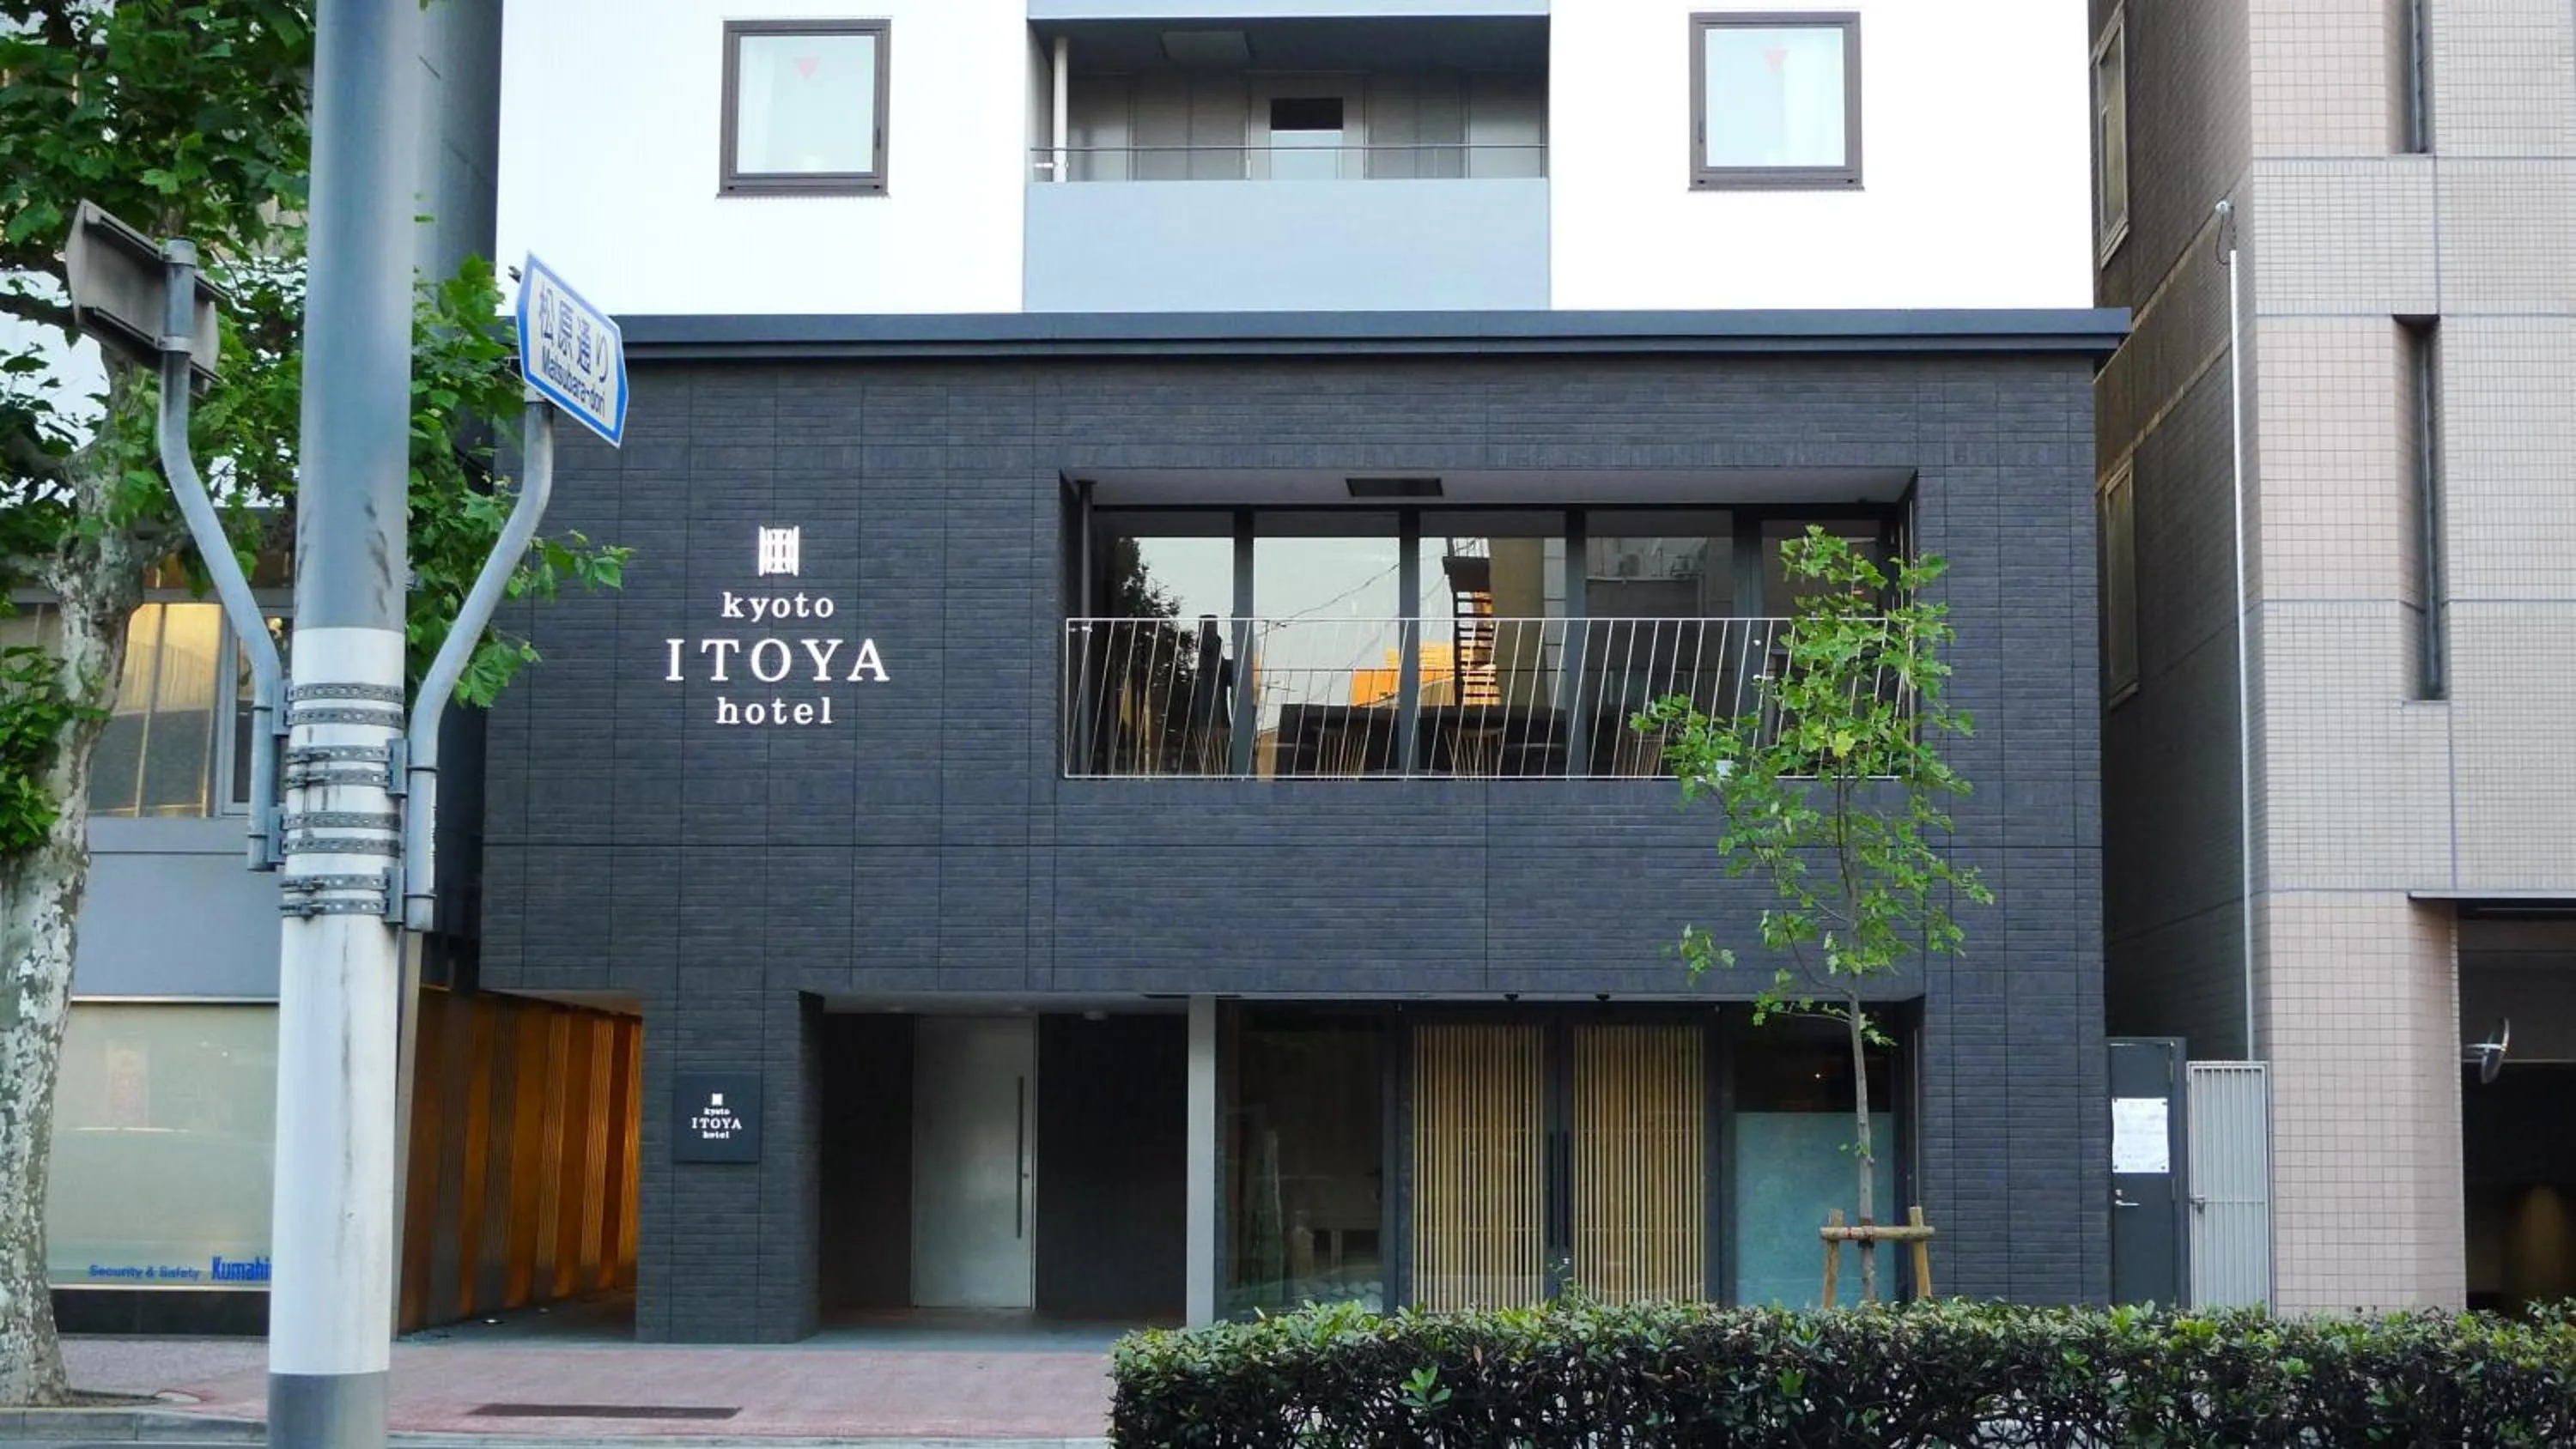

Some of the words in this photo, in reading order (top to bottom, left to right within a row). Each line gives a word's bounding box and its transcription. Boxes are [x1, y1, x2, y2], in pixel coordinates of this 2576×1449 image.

[542, 345, 605, 418] Matsubara-dori
[720, 591, 835, 623] kyoto
[665, 638, 890, 682] ITOYA
[716, 696, 835, 724] hotel
[691, 1117, 743, 1130] ITOYA
[703, 1106, 731, 1116] kyoto
[702, 1131, 730, 1139] hotel
[88, 1264, 143, 1280] Security
[145, 1265, 155, 1278] &
[159, 1266, 201, 1282] Safety
[211, 1256, 271, 1281] Kumahi
